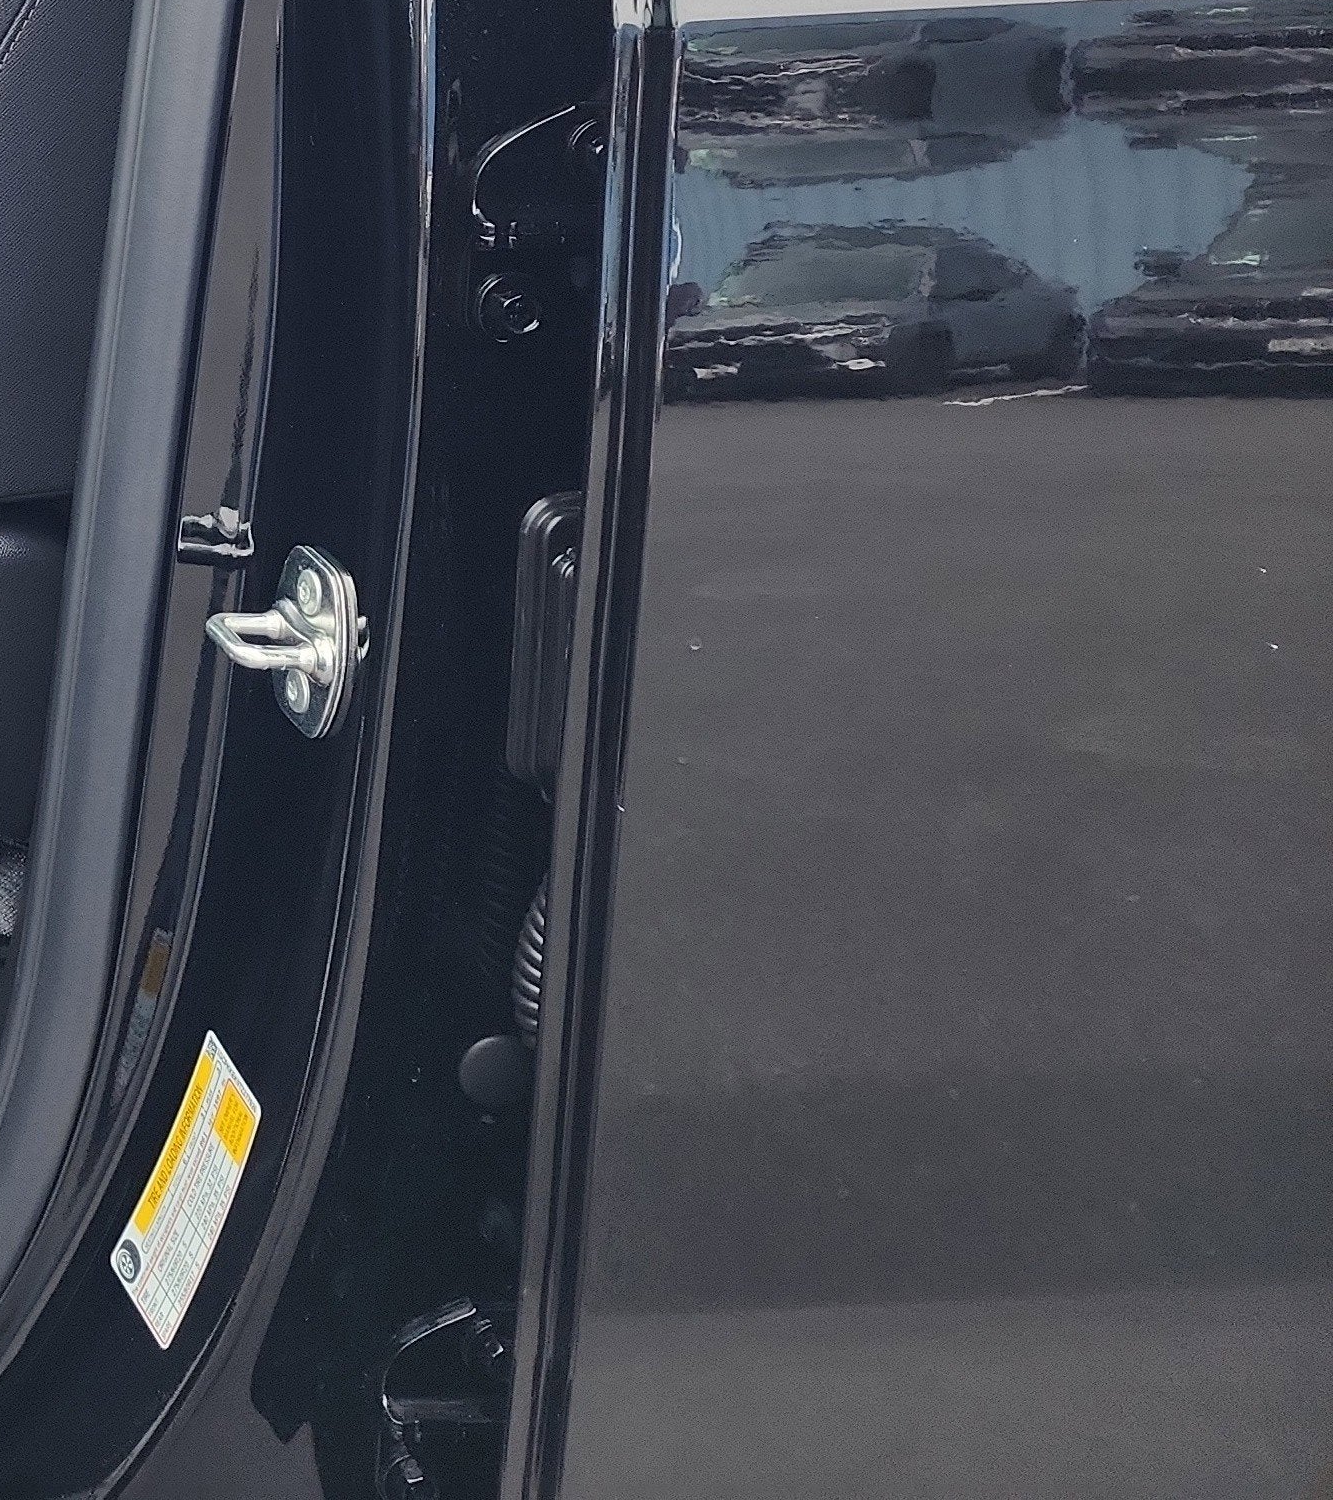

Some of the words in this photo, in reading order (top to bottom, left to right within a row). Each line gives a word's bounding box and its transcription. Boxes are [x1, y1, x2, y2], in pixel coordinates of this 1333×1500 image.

[148, 1186, 160, 1209] TIRE
[156, 1168, 168, 1193] AND
[163, 1134, 183, 1175] LOADING
[179, 1081, 202, 1139] INFORMATION
